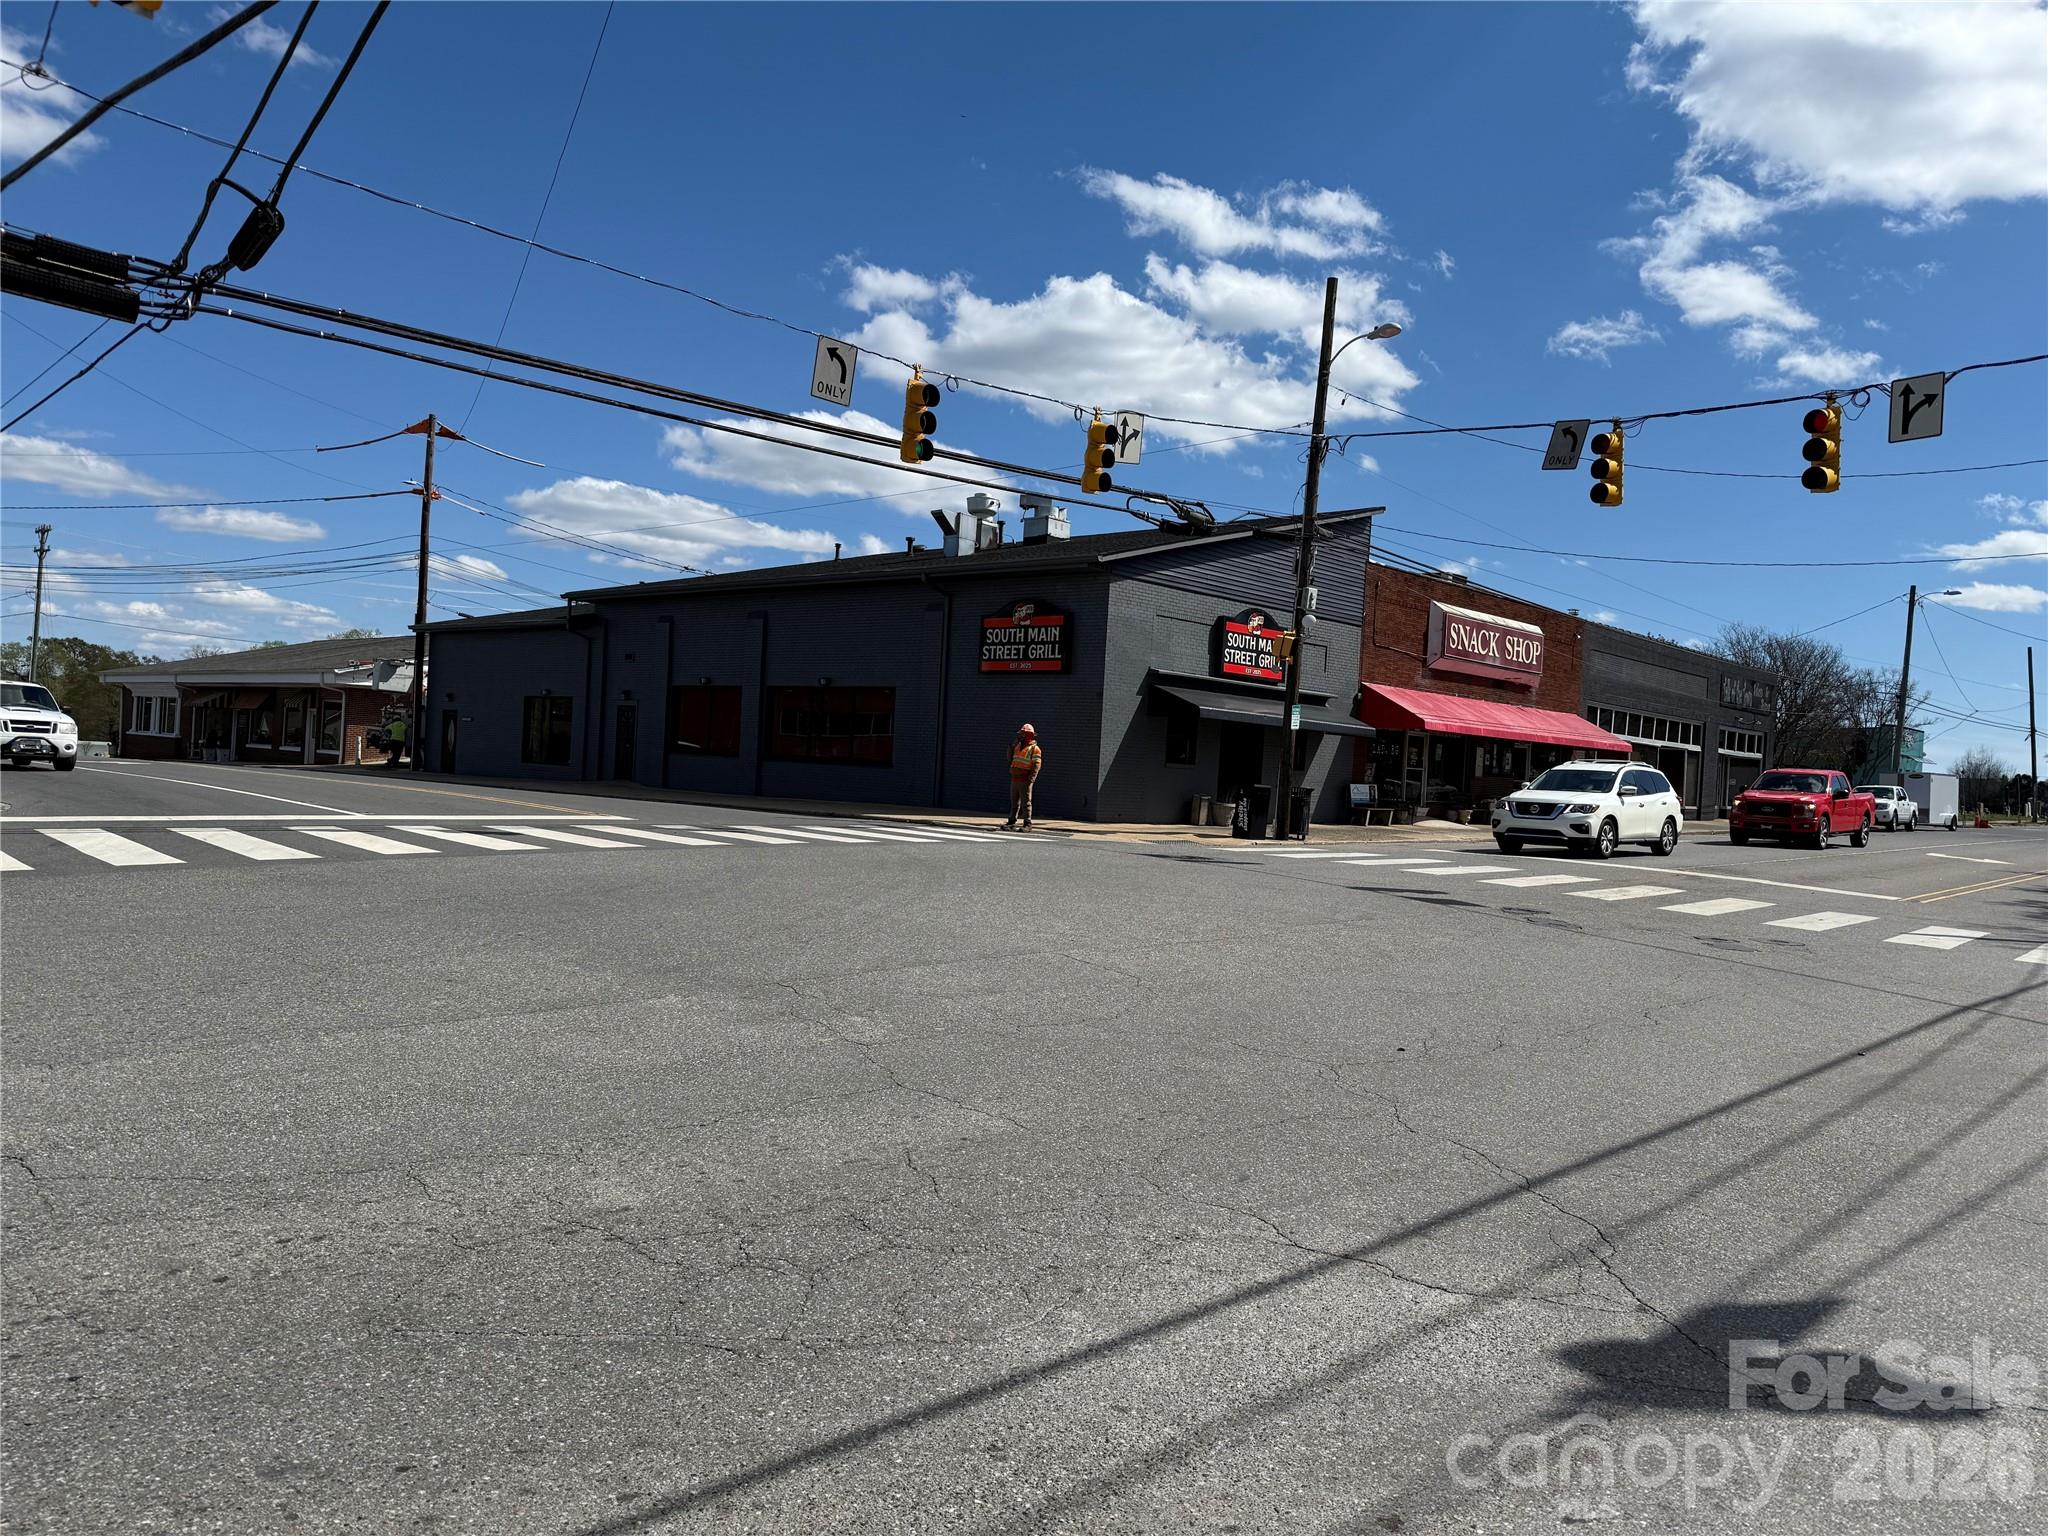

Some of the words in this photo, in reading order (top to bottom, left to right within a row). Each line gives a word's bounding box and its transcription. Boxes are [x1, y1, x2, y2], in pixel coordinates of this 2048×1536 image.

[817, 381, 846, 399] ONLY
[1548, 456, 1575, 465] ONLY
[986, 629, 1024, 643] SOUTH
[1028, 627, 1060, 641] MAIN
[1227, 633, 1256, 651] SOUTH
[1258, 639, 1279, 654] MA
[1449, 622, 1500, 657] SNACK
[1505, 635, 1541, 664] SHOP
[982, 645, 1026, 659] STREET
[1029, 644, 1061, 658] GRILL
[1224, 648, 1257, 666] STREET
